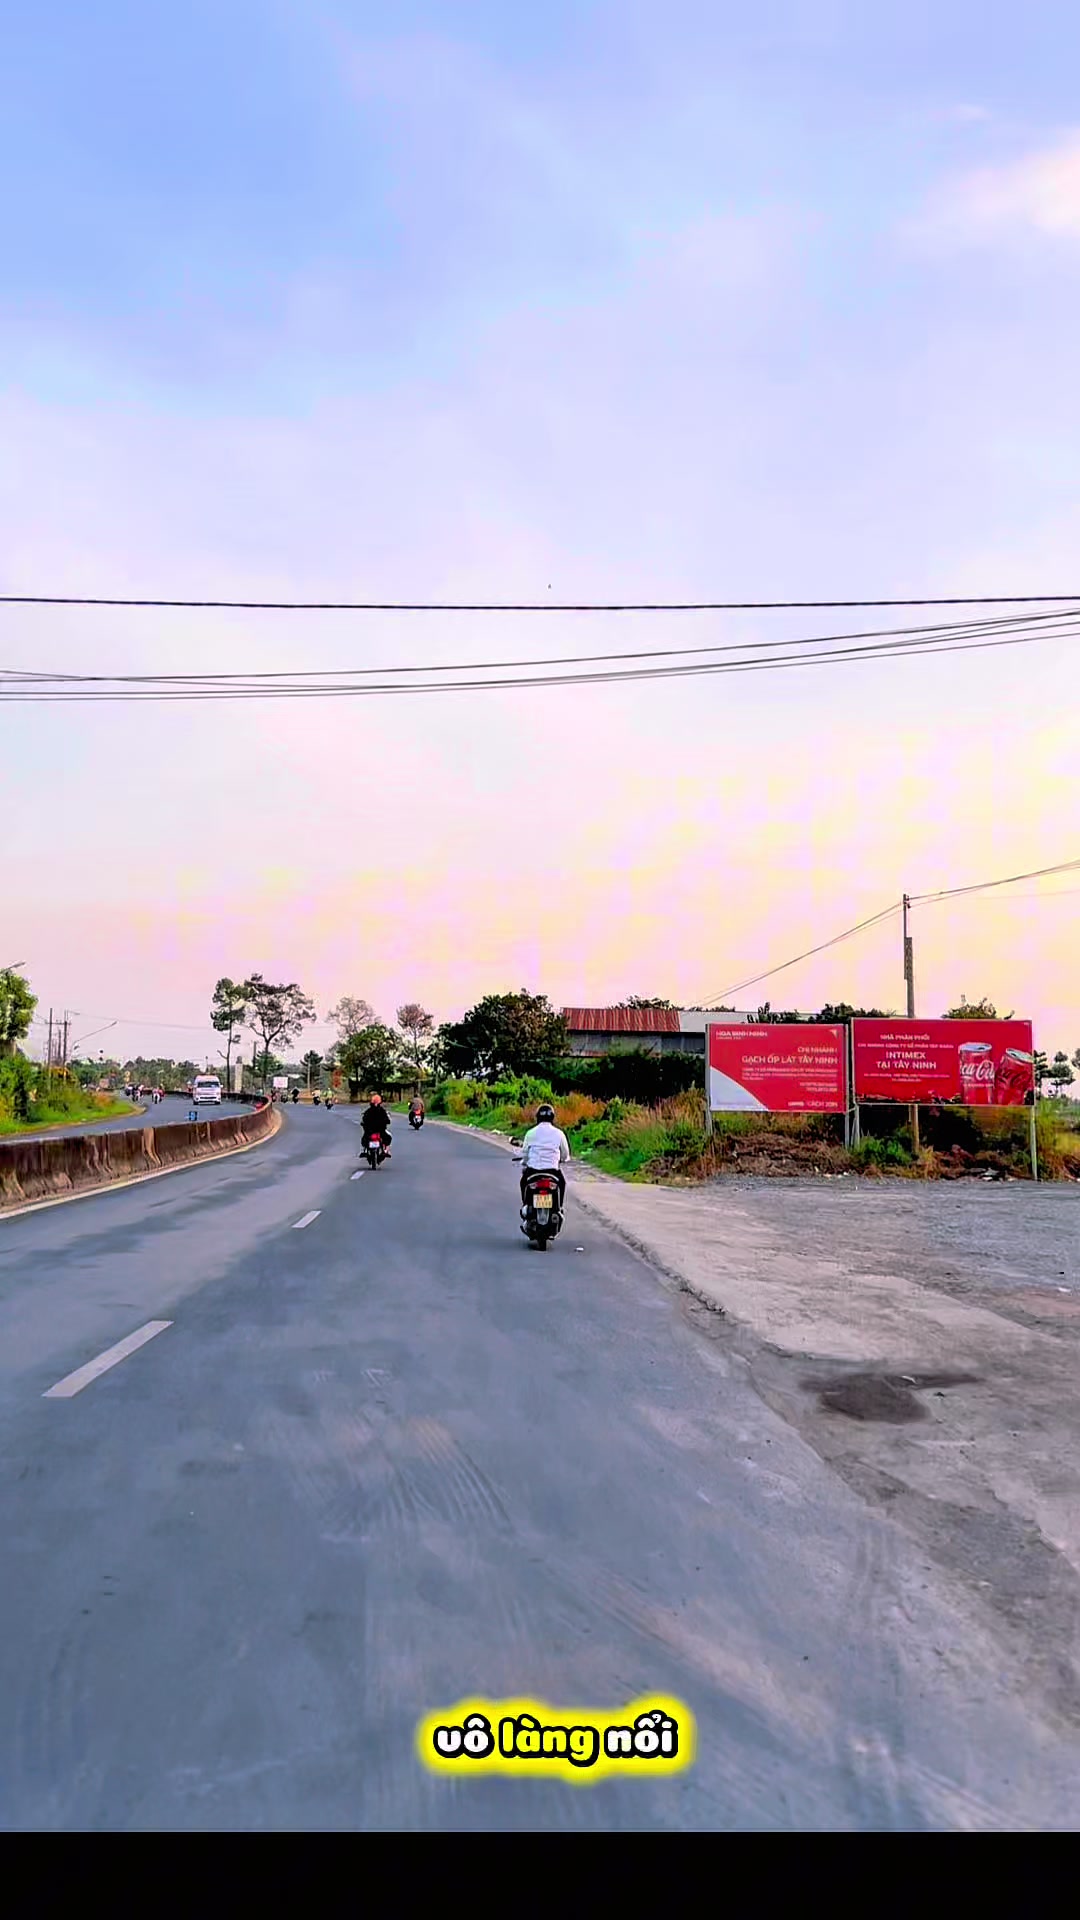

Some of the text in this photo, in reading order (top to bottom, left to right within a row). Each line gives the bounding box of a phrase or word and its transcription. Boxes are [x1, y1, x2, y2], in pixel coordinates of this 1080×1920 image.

[741, 1055, 766, 1065] GẠCH
[767, 1053, 780, 1064] ỐP
[798, 1054, 814, 1065] TÂY
[814, 1056, 838, 1065] NINH
[885, 1051, 927, 1060] INTIMEX
[876, 1060, 937, 1070] TẠI TÂY NINH
